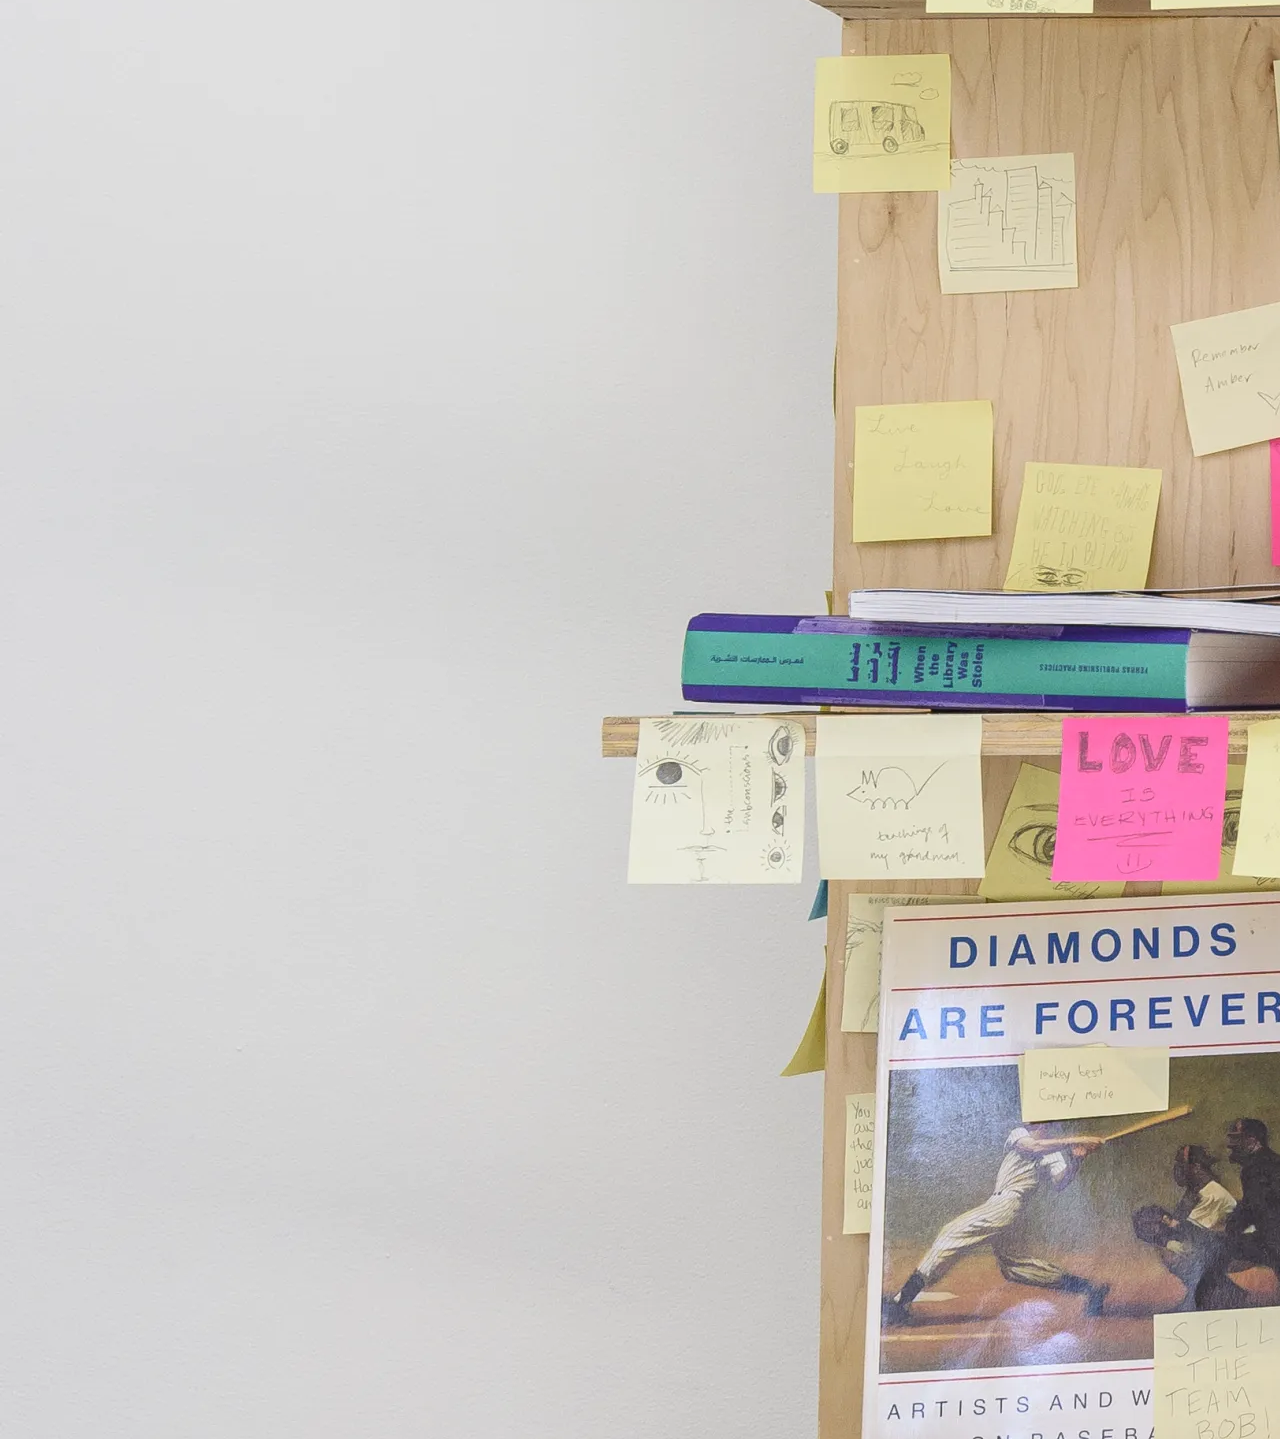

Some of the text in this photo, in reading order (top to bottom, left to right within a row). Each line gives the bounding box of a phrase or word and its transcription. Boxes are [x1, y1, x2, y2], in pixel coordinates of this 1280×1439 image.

[913, 645, 927, 686] When
[929, 653, 940, 676] the
[943, 641, 959, 691] Library
[957, 649, 969, 680] Was
[972, 643, 985, 689] Stolen
[1076, 731, 1210, 776] LOVE
[1120, 786, 1156, 804] IS
[1073, 807, 1215, 829] EVERYTHING
[949, 922, 1238, 969] DIAMONDS
[899, 1003, 1006, 1041] ARE
[1160, 1321, 1276, 1357] SELL
[1185, 1355, 1251, 1381] THE
[887, 1391, 1114, 1420] ARTISTS AND
[1164, 1389, 1252, 1416] TEAM
